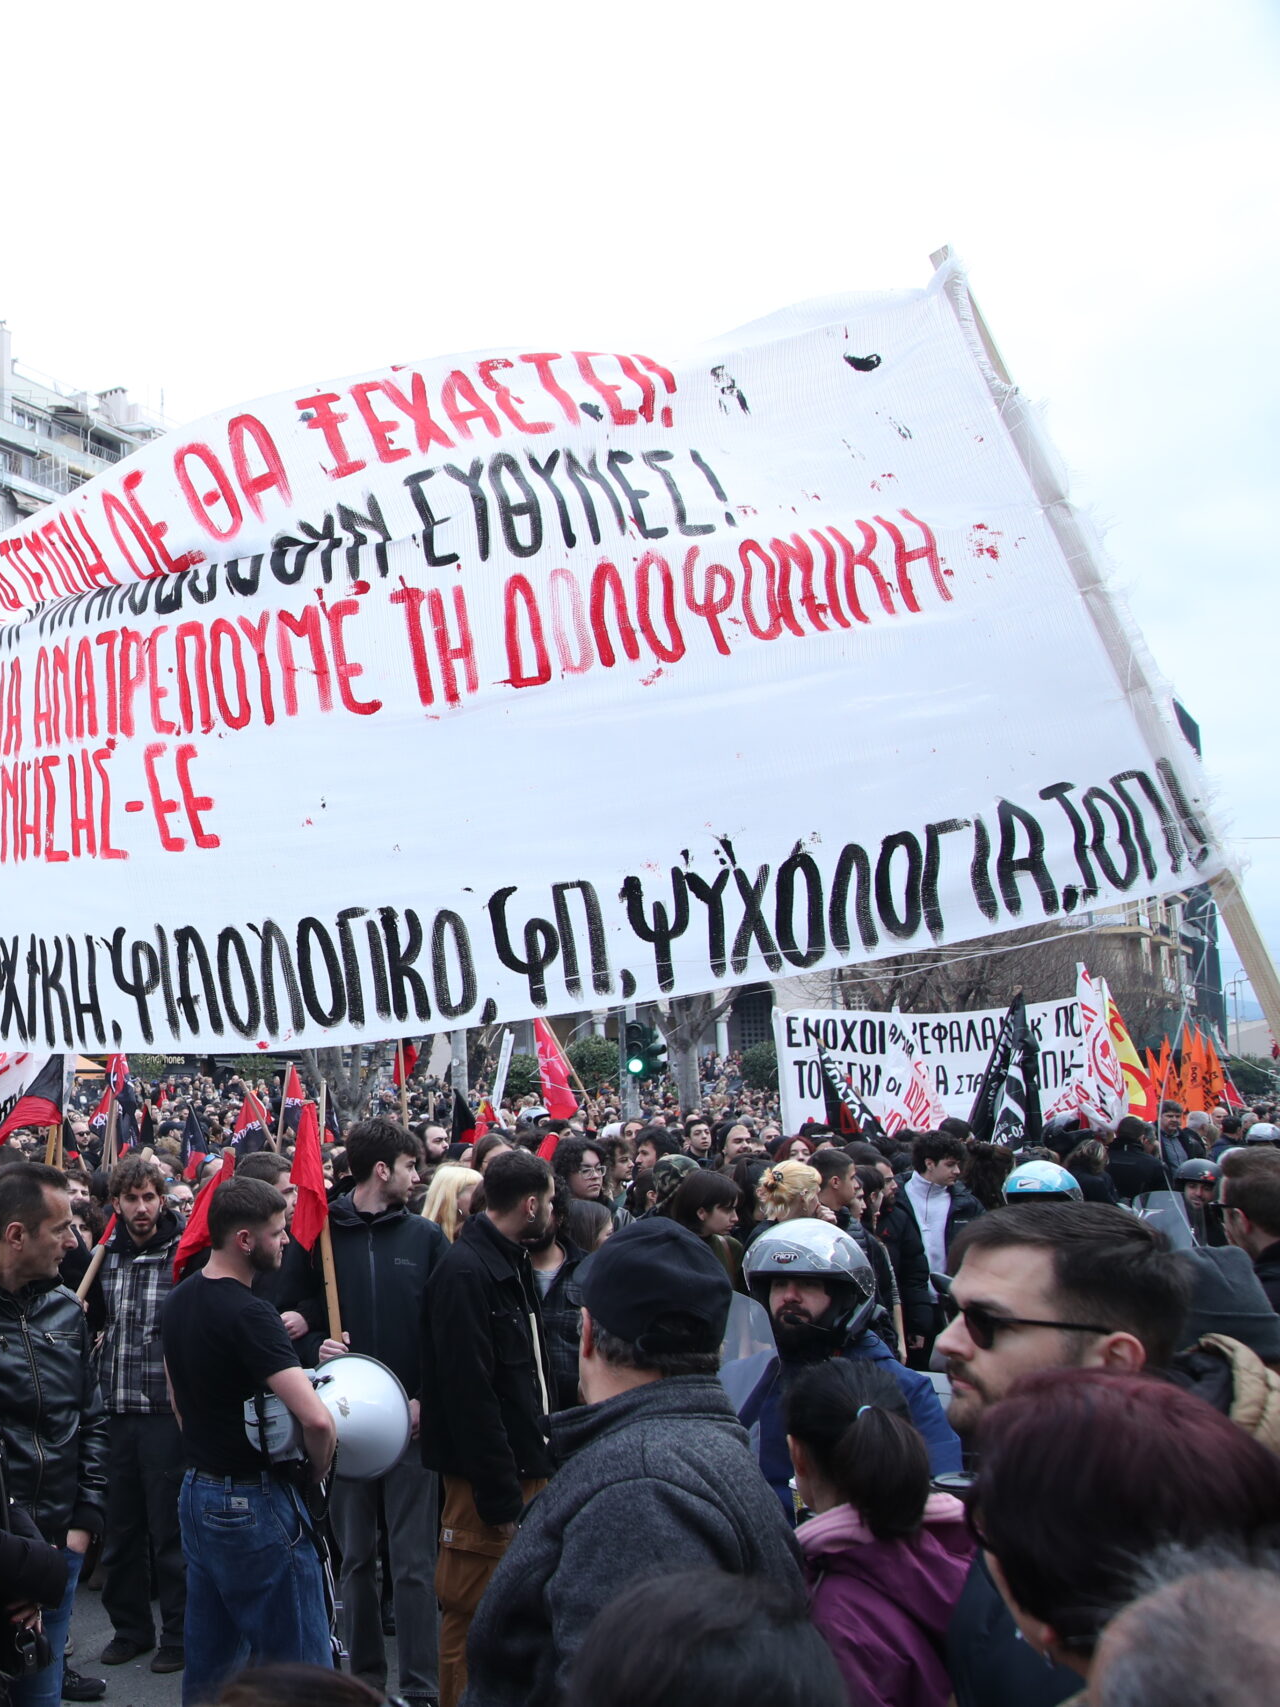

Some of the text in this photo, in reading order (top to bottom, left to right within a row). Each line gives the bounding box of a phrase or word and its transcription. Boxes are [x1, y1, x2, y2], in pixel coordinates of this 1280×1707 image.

[102, 469, 207, 581] ΔΕ
[173, 413, 292, 542] ΘΑ
[403, 446, 739, 567] ΕΥΘΥΝΕΣ!
[33, 600, 382, 748] ΑΝΑΤΡΕΠΟΥΜΕ
[388, 580, 478, 709] ΤΗ
[492, 507, 953, 688] ΔΟΛΟΦΟΝΙΚΗ
[786, 1016, 886, 1054] ΕΝΟΧΟΙ
